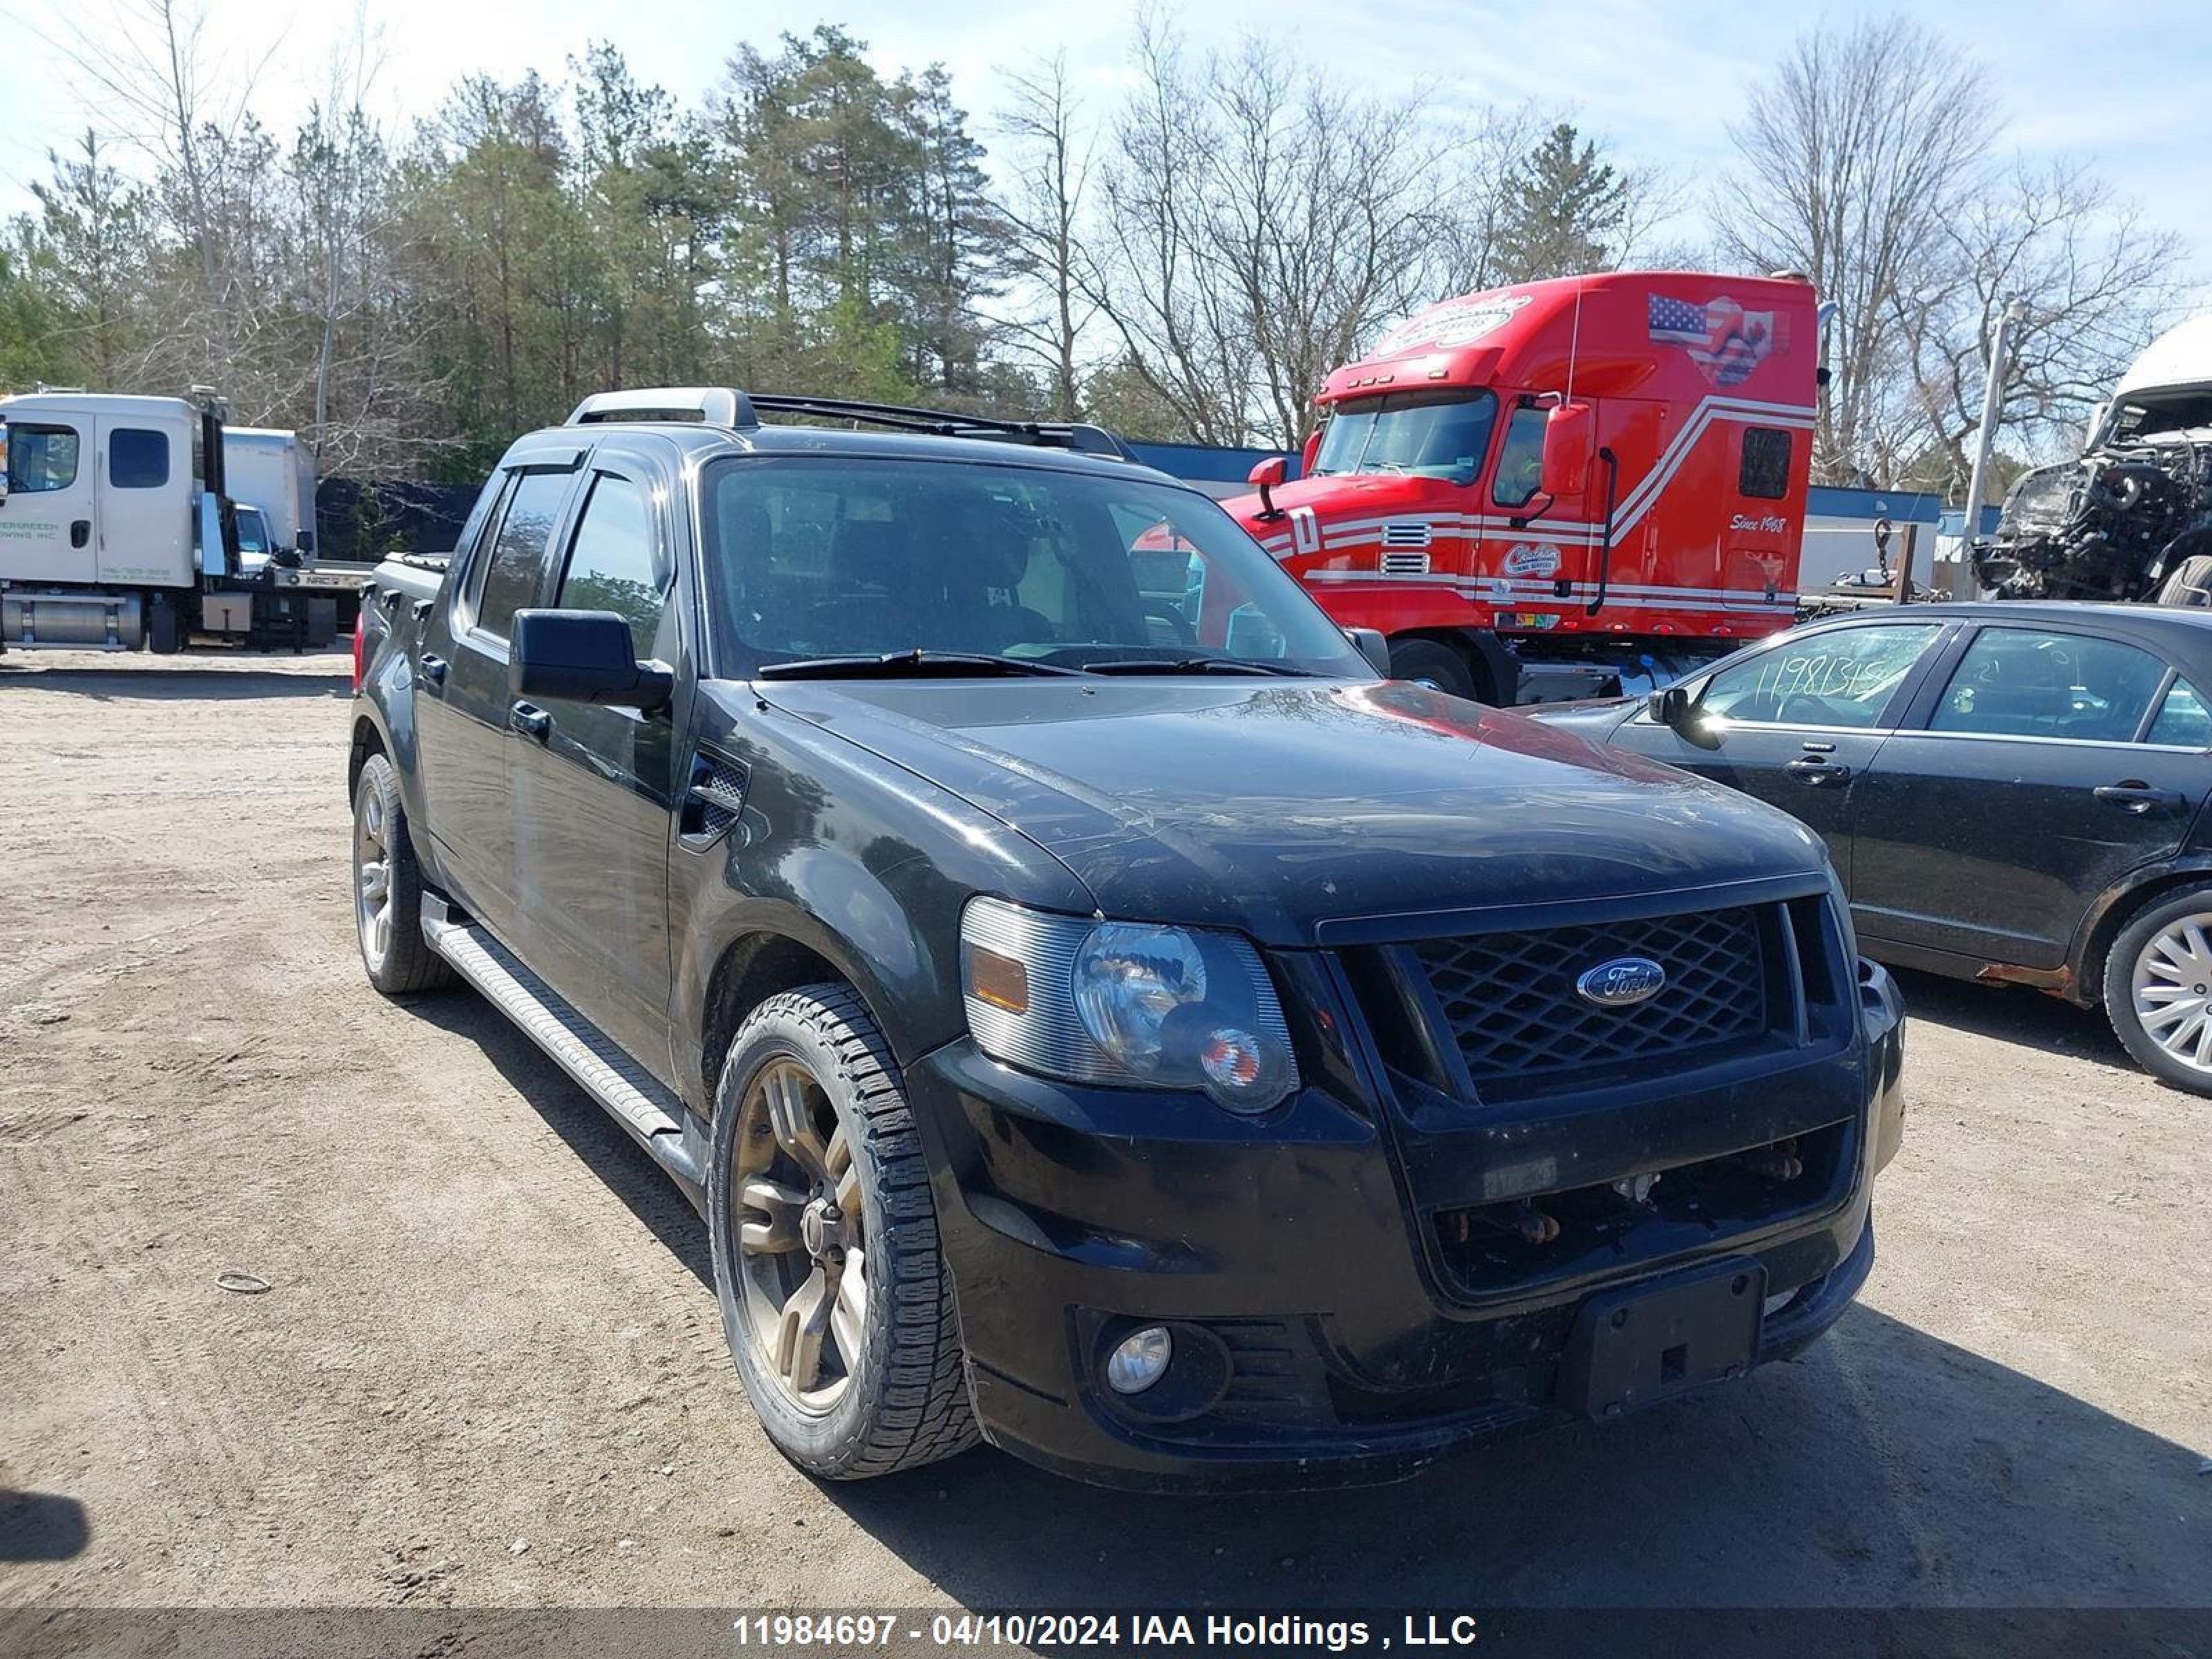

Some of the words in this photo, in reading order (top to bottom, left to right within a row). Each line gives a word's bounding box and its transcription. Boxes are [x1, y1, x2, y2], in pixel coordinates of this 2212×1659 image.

[1730, 514, 1758, 530] Since
[1759, 516, 1787, 532] 1968
[1604, 966, 1651, 996] Ford
